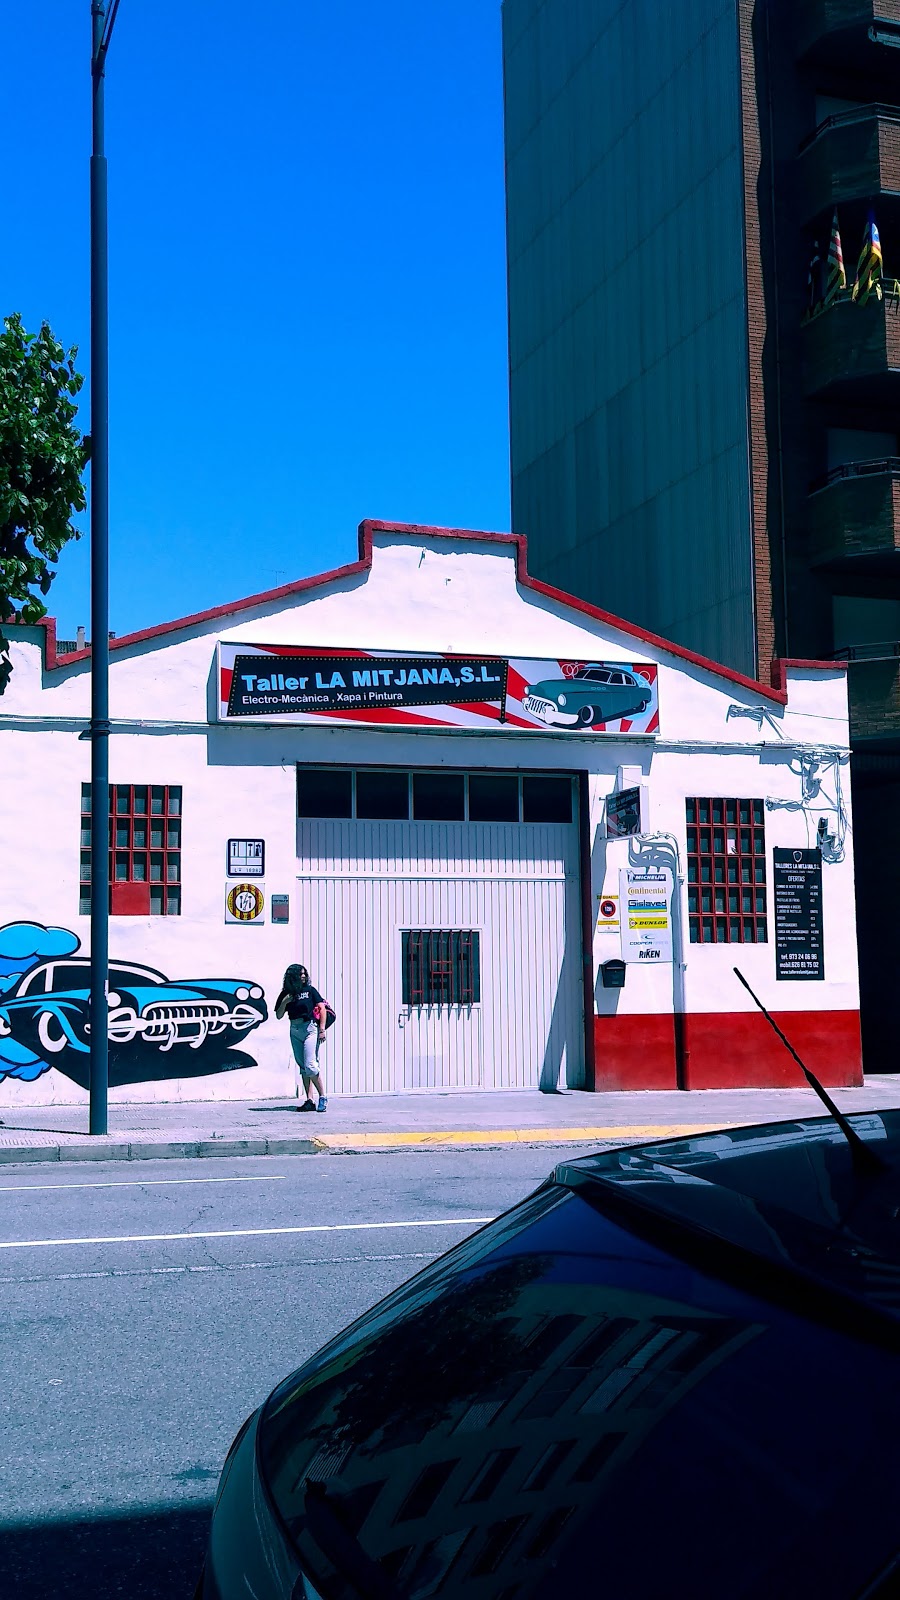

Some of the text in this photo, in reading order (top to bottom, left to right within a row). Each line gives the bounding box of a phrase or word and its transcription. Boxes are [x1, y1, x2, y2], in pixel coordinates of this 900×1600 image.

[241, 674, 309, 692] Taller
[315, 671, 346, 689] LA
[242, 693, 329, 705] Electro-Mecànica
[336, 692, 362, 703] Xapa
[368, 691, 403, 701] Pintura
[628, 887, 667, 895] Continental
[638, 948, 660, 958] RIKEN
